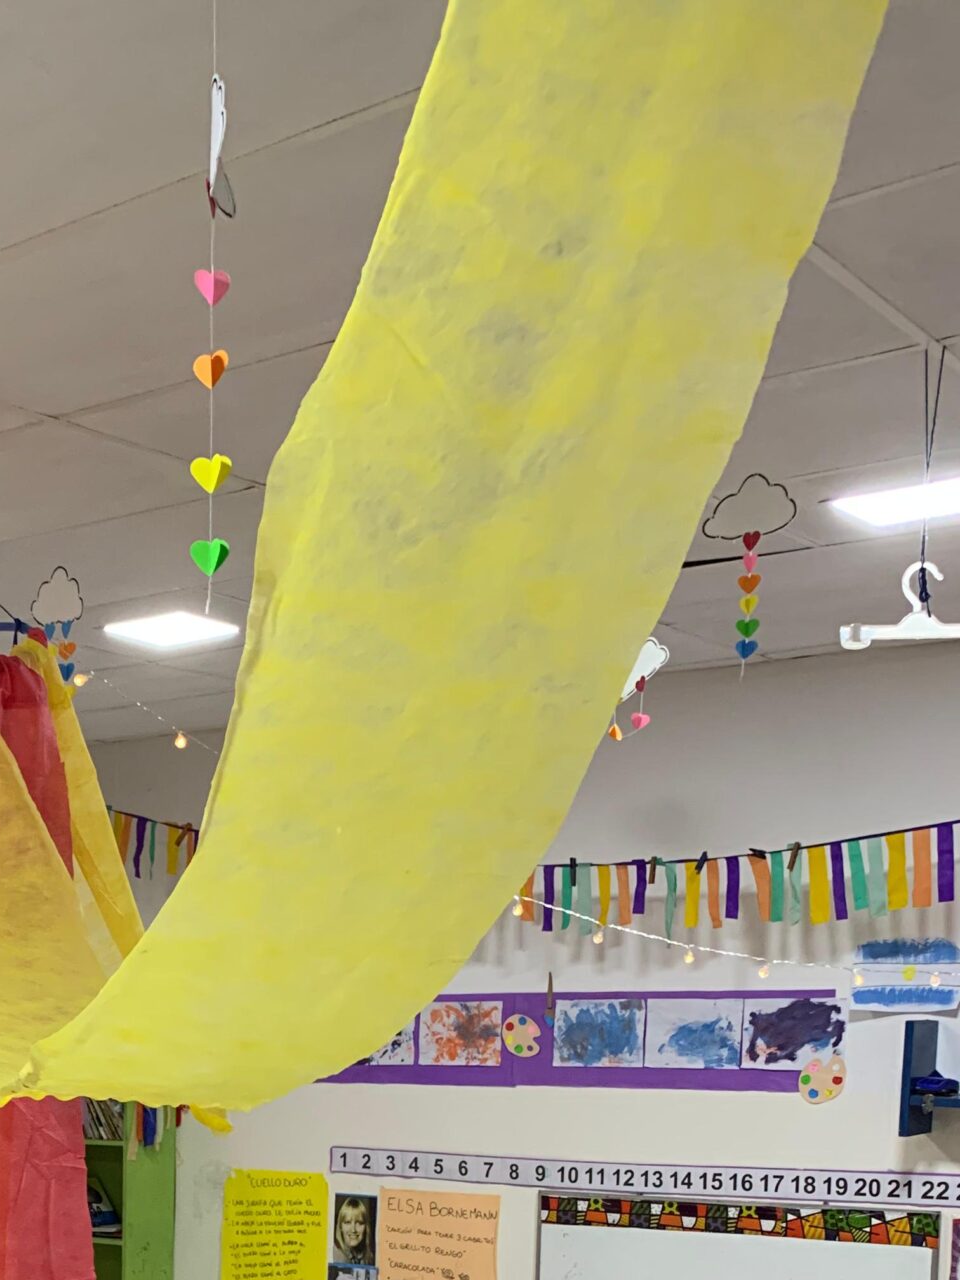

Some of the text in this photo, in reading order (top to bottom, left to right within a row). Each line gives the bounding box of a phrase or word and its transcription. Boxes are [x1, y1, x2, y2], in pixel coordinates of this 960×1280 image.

[340, 1152, 347, 1168] 1
[362, 1153, 371, 1169] 2
[386, 1155, 395, 1170] 3
[409, 1156, 419, 1172] 4
[433, 1158, 443, 1174] 5
[458, 1160, 468, 1176] 6
[483, 1161, 493, 1178] 7
[509, 1163, 519, 1180] 8
[535, 1165, 546, 1181] 9
[557, 1166, 578, 1184] 10
[585, 1167, 605, 1185] 11
[613, 1169, 635, 1186] 12
[640, 1170, 663, 1188] 13
[670, 1171, 693, 1189] 14
[699, 1172, 723, 1190] 15
[729, 1173, 753, 1192] 16
[760, 1174, 784, 1193] 17
[791, 1175, 816, 1194] 18
[823, 1177, 848, 1196] 19
[854, 1178, 881, 1197] 20
[887, 1179, 913, 1199] 21
[921, 1181, 950, 1200] 22
[387, 1197, 497, 1220] ELSA BORNEMANN
